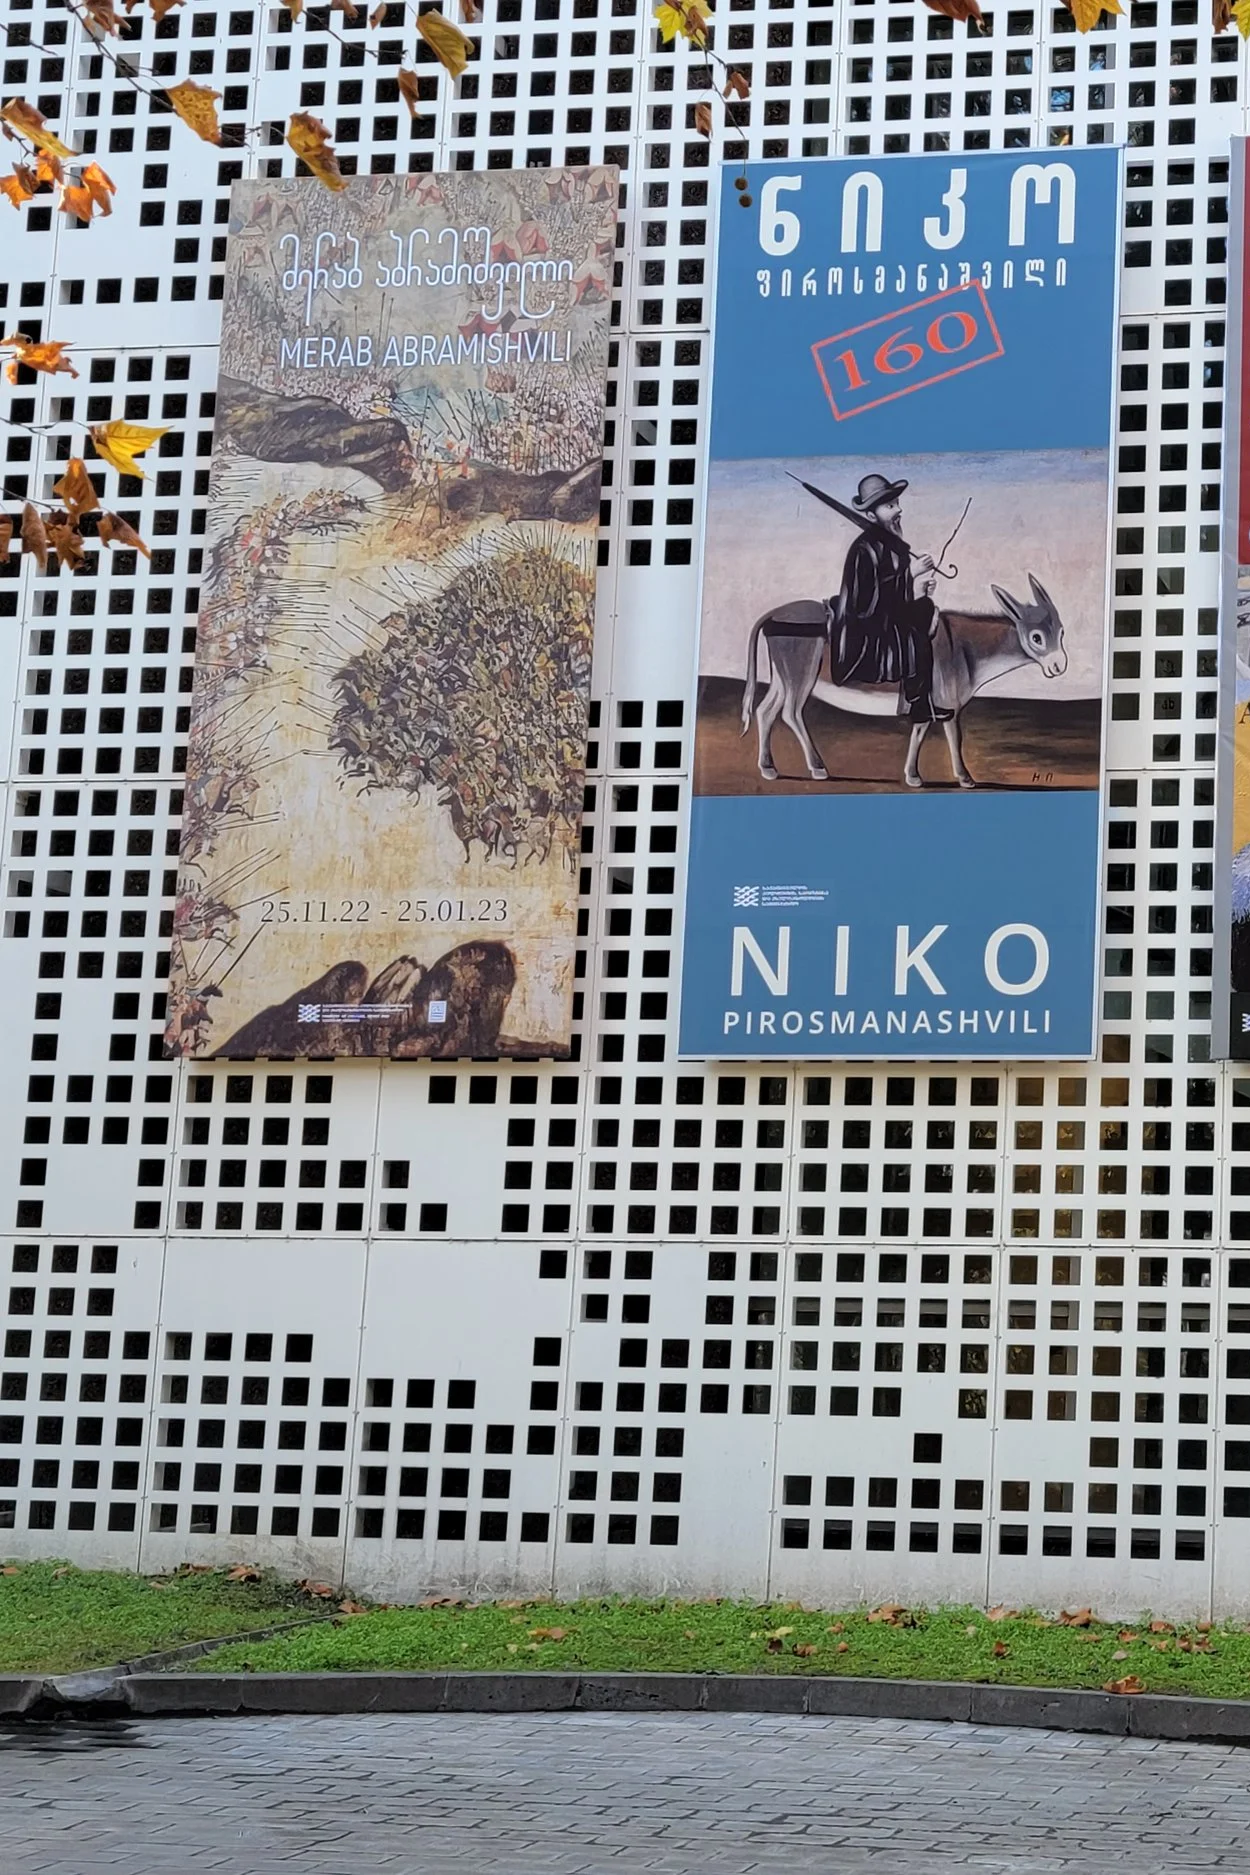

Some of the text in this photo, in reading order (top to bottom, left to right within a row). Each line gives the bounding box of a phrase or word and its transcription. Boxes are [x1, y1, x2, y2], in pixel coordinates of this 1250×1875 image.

[758, 162, 1077, 257] ნიკო
[756, 257, 1067, 298] ფიროსმანაშვილი
[280, 330, 572, 369] MERAB ABRAMISHVILI
[833, 311, 978, 393] 160
[260, 900, 371, 924] 25.11.22
[397, 898, 509, 923] 25.01.23
[730, 922, 1050, 998] NIKO
[723, 1010, 1051, 1035] PIROSMANASHVILI
